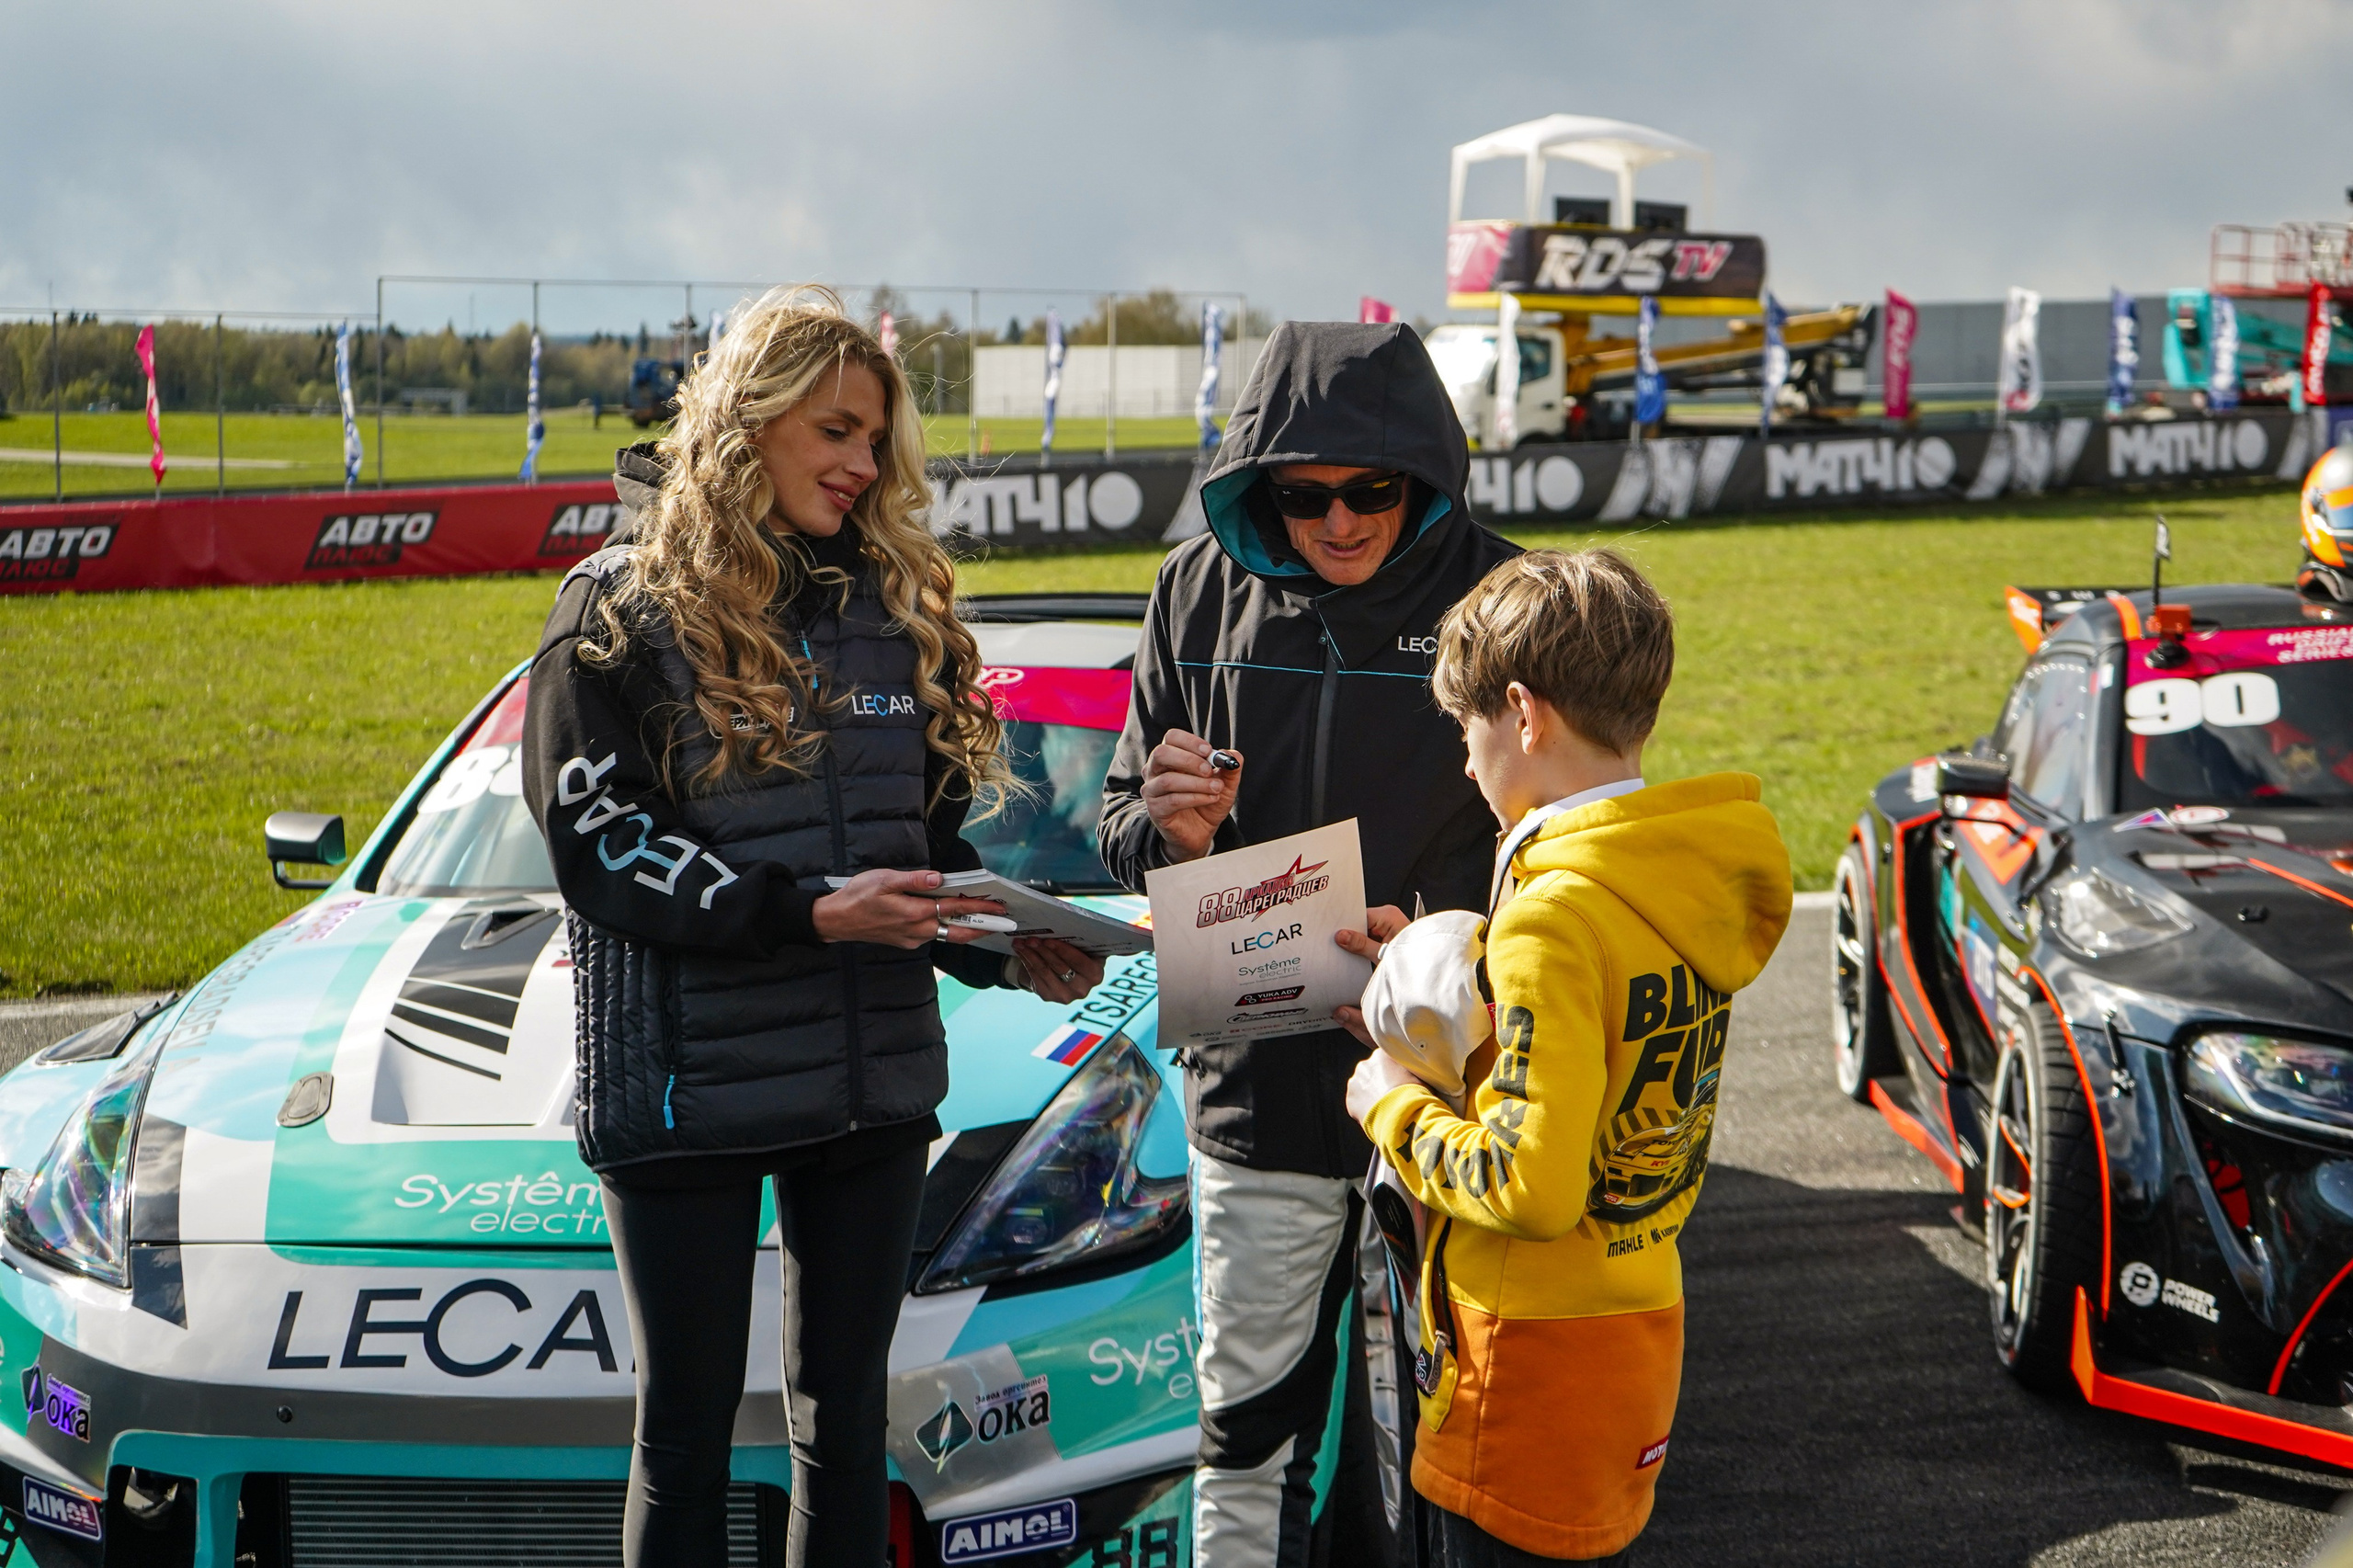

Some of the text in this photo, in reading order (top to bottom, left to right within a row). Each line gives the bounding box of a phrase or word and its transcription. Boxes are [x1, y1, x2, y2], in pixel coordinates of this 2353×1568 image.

[1534, 234, 1673, 291] RDS
[1671, 240, 1734, 280] TV
[319, 512, 434, 548] АВТО
[551, 504, 629, 535] АВТ
[0, 526, 111, 560] АВТО
[1398, 636, 1438, 653] LEC
[852, 695, 915, 716] LECAR
[2124, 672, 2280, 735] 90
[558, 752, 739, 910] LECAR
[1196, 887, 1241, 928] 88
[1234, 875, 1329, 919] ЦАРЕГРАДЦЕВ
[1231, 923, 1302, 955] LECAR
[1622, 964, 1733, 1041] BLIN
[394, 1171, 602, 1212] Systêm
[470, 1207, 606, 1233] electr
[1608, 1234, 1644, 1257] MAHLE
[2162, 1290, 2220, 1324] WHEELS
[2164, 1278, 2216, 1307] POWER
[267, 1278, 636, 1377] LECA
[1089, 1317, 1195, 1385] Syst
[27, 1487, 96, 1526] AIMOL
[948, 1510, 1069, 1555] AIMOL
